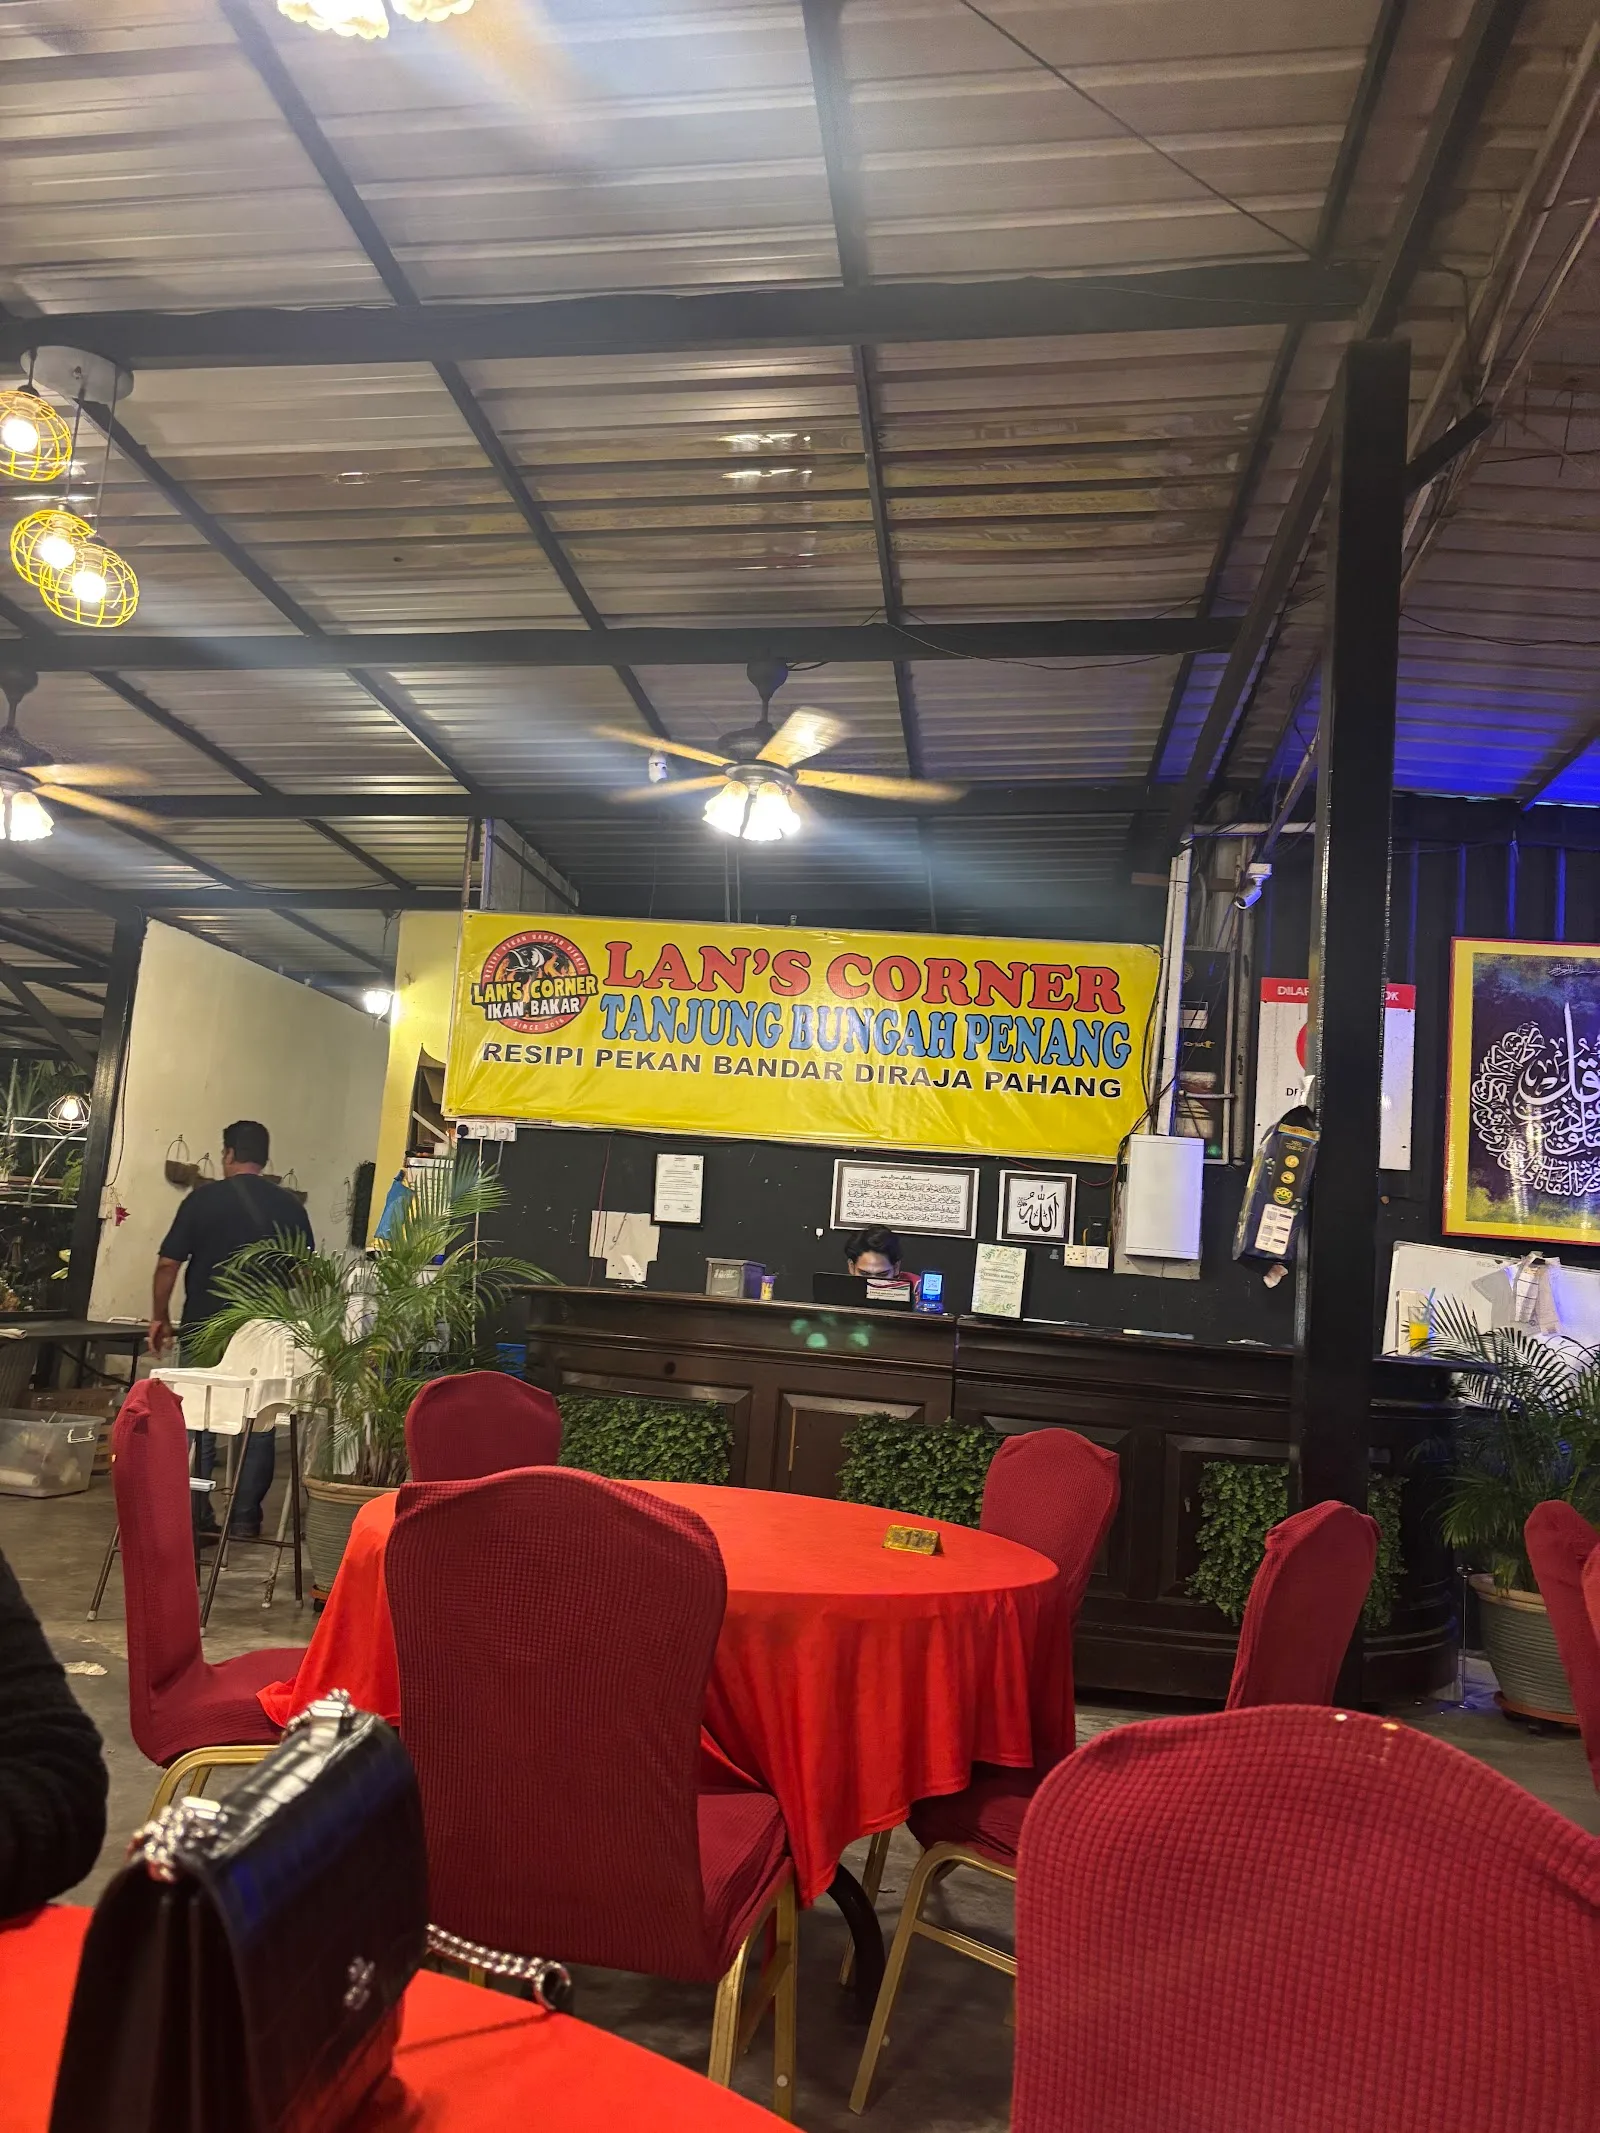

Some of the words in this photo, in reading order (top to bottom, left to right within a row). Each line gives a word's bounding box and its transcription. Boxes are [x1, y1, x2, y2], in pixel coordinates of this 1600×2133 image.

[501, 935, 528, 951] PEKAN
[531, 934, 564, 946] BANDAR
[566, 945, 588, 972] DIRAJA
[473, 981, 523, 1004] LAN'S
[530, 975, 597, 999] CORNER
[602, 940, 812, 997] LAN'S
[825, 952, 1126, 1015] CORNER
[1277, 985, 1310, 996] DILAR
[487, 1001, 524, 1019] IKAN
[530, 997, 580, 1016] BAKAR
[512, 1021, 539, 1031] SINCE
[600, 994, 784, 1049] TANJUNG
[789, 1004, 958, 1060] BUNGAH
[963, 1013, 1132, 1070] PENANG
[482, 1042, 584, 1066] RESIPI
[595, 1049, 701, 1074] PEKAN
[713, 1055, 843, 1083] BANDAR
[855, 1063, 972, 1090] DIRAJA
[985, 1071, 1121, 1099] PAHANG
